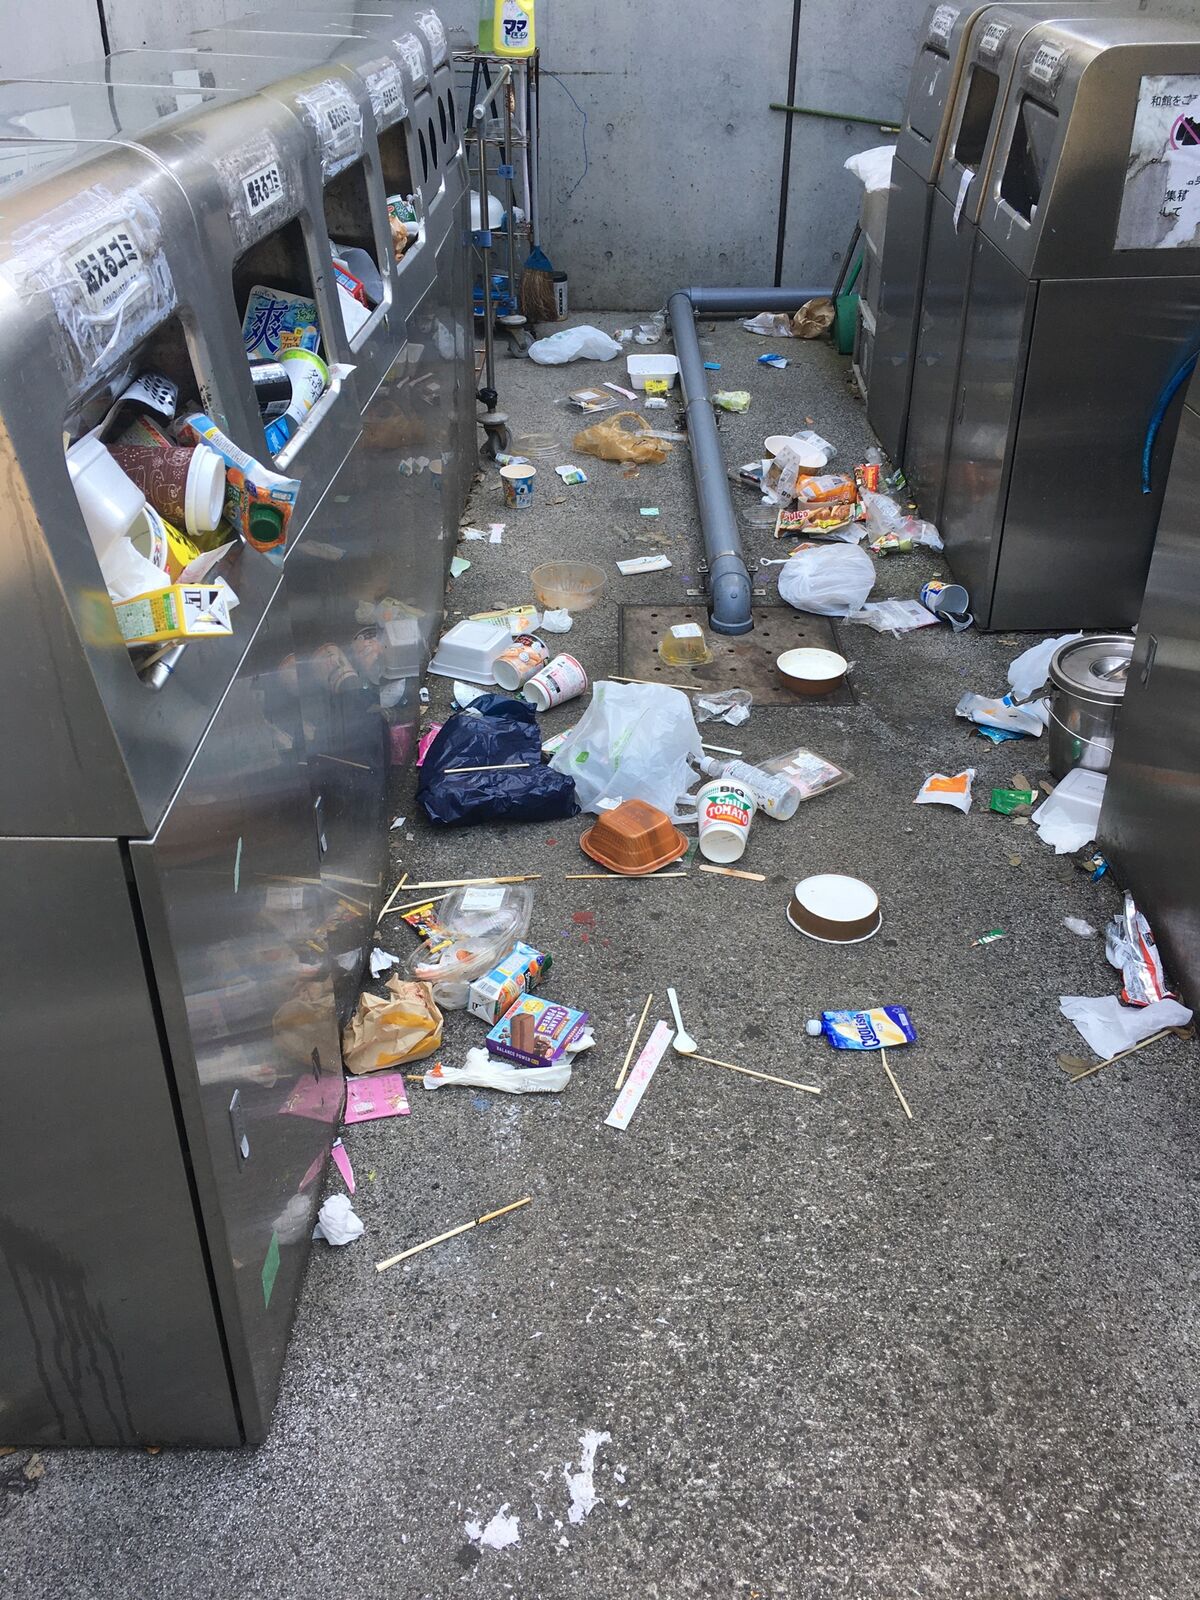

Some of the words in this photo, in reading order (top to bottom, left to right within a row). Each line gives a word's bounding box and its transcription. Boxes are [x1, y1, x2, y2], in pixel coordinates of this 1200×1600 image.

[503, 19, 527, 35] ママ
[246, 169, 280, 207] 燃えるゴミ
[74, 233, 138, 296] 燃えるゴミ
[245, 299, 289, 354] 爽
[716, 796, 745, 810] Chili
[720, 785, 745, 798] BIG
[708, 805, 749, 826] TOMATO
[545, 1009, 567, 1034] BALANCE
